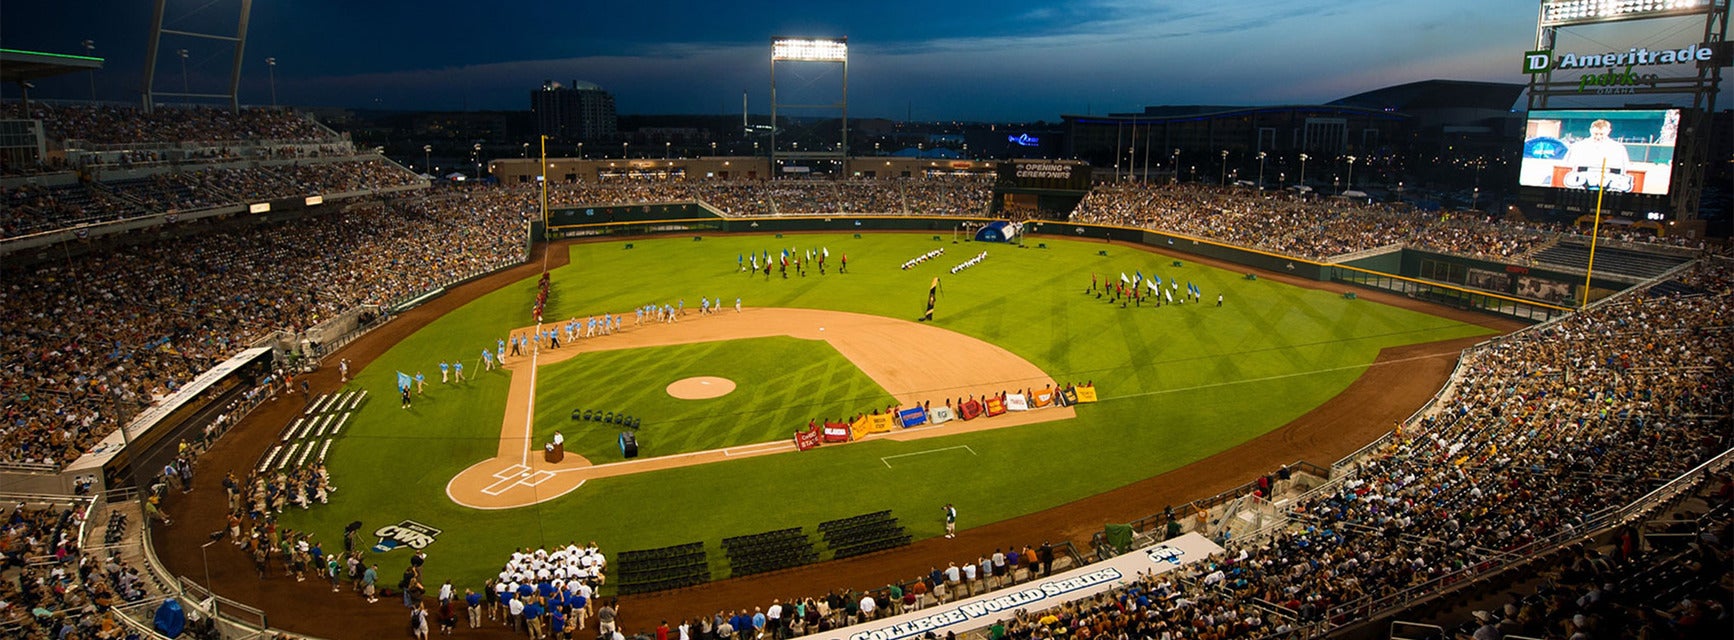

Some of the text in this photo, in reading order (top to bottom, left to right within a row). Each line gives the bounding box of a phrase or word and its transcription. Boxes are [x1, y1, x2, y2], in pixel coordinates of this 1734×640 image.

[1526, 45, 1712, 70] TD Ameritrade
[1578, 64, 1637, 93] park
[1016, 170, 1071, 179] CEREMONIES
[1025, 163, 1063, 171] OPENING
[374, 525, 435, 549] CWS
[850, 567, 1123, 640] COLLEGE WORLD SERIES
